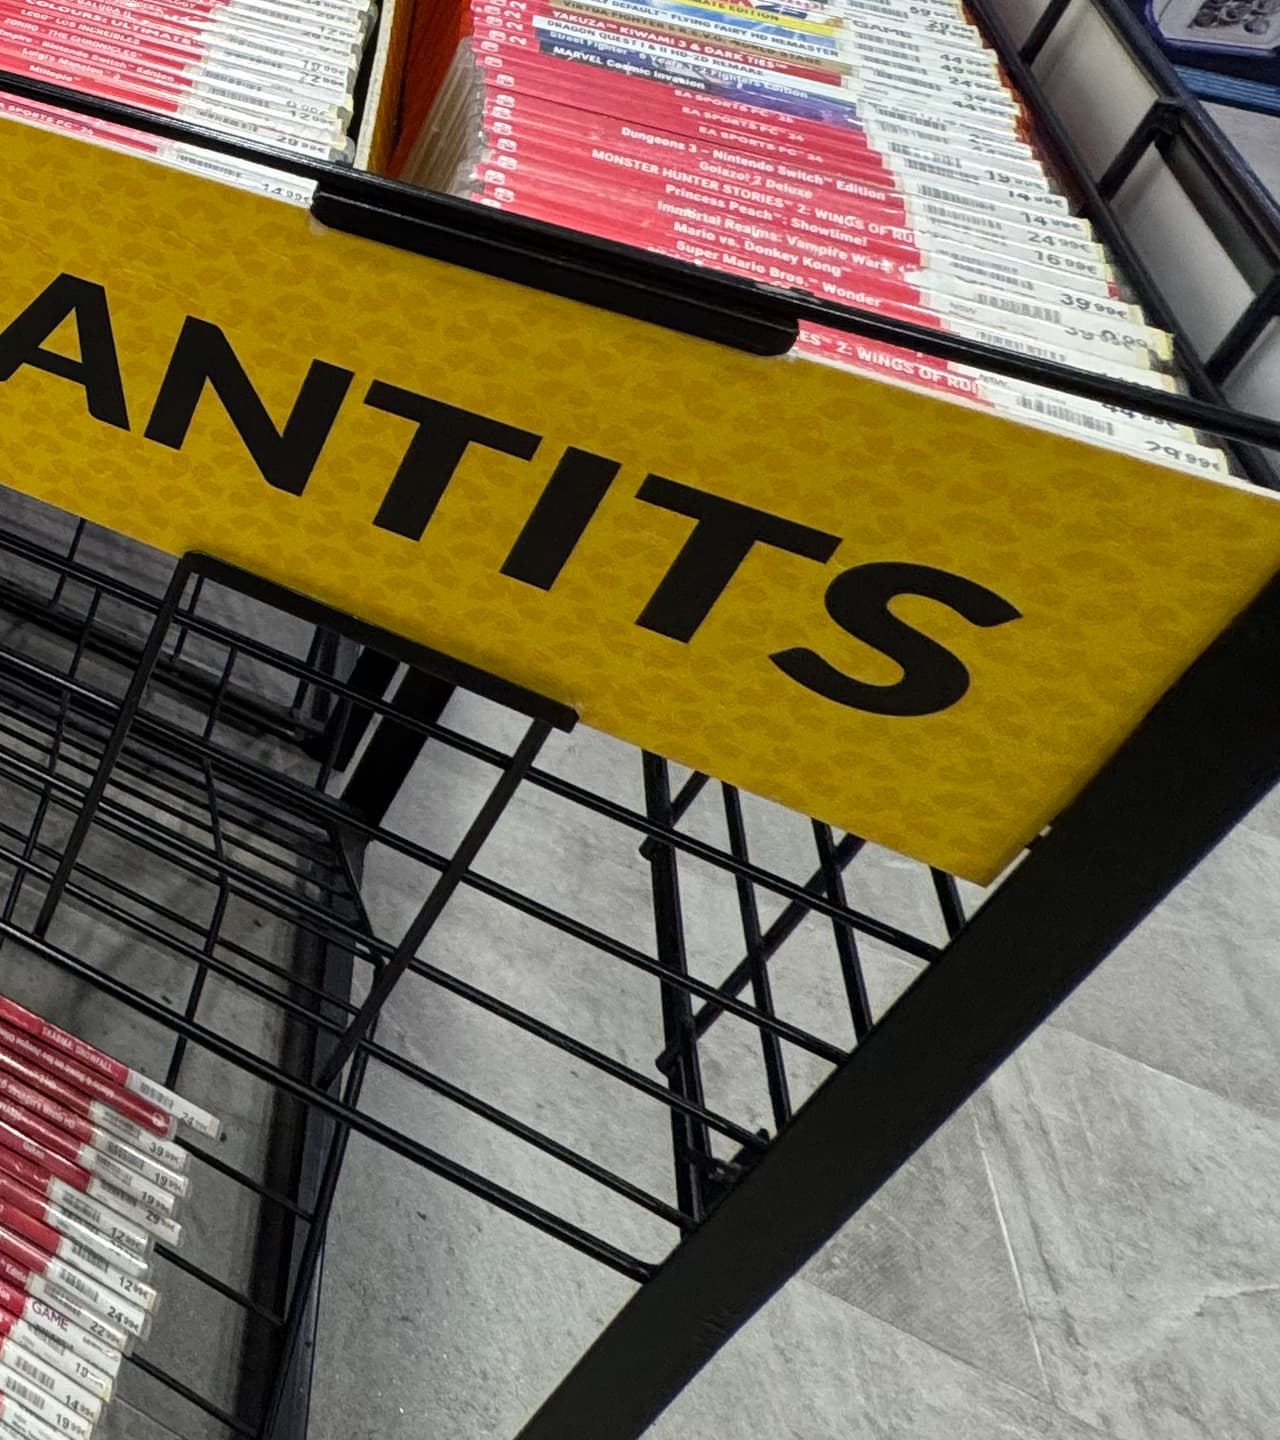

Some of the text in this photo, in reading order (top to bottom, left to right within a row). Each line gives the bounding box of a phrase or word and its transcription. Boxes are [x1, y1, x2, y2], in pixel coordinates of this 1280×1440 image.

[592, 149, 658, 175] MONSTER
[662, 166, 719, 190] HUNTER
[816, 207, 864, 229] WINGS
[868, 223, 890, 236] OF
[621, 127, 685, 151] Dungeons
[689, 142, 697, 152] 3
[713, 149, 774, 171] Nintendo
[836, 181, 886, 200] Edition
[674, 222, 715, 241] Mario
[719, 234, 741, 248] vs.
[744, 241, 798, 265] Donkey
[676, 240, 719, 260] Super
[722, 253, 766, 274] Mario
[822, 281, 882, 307] Wonder
